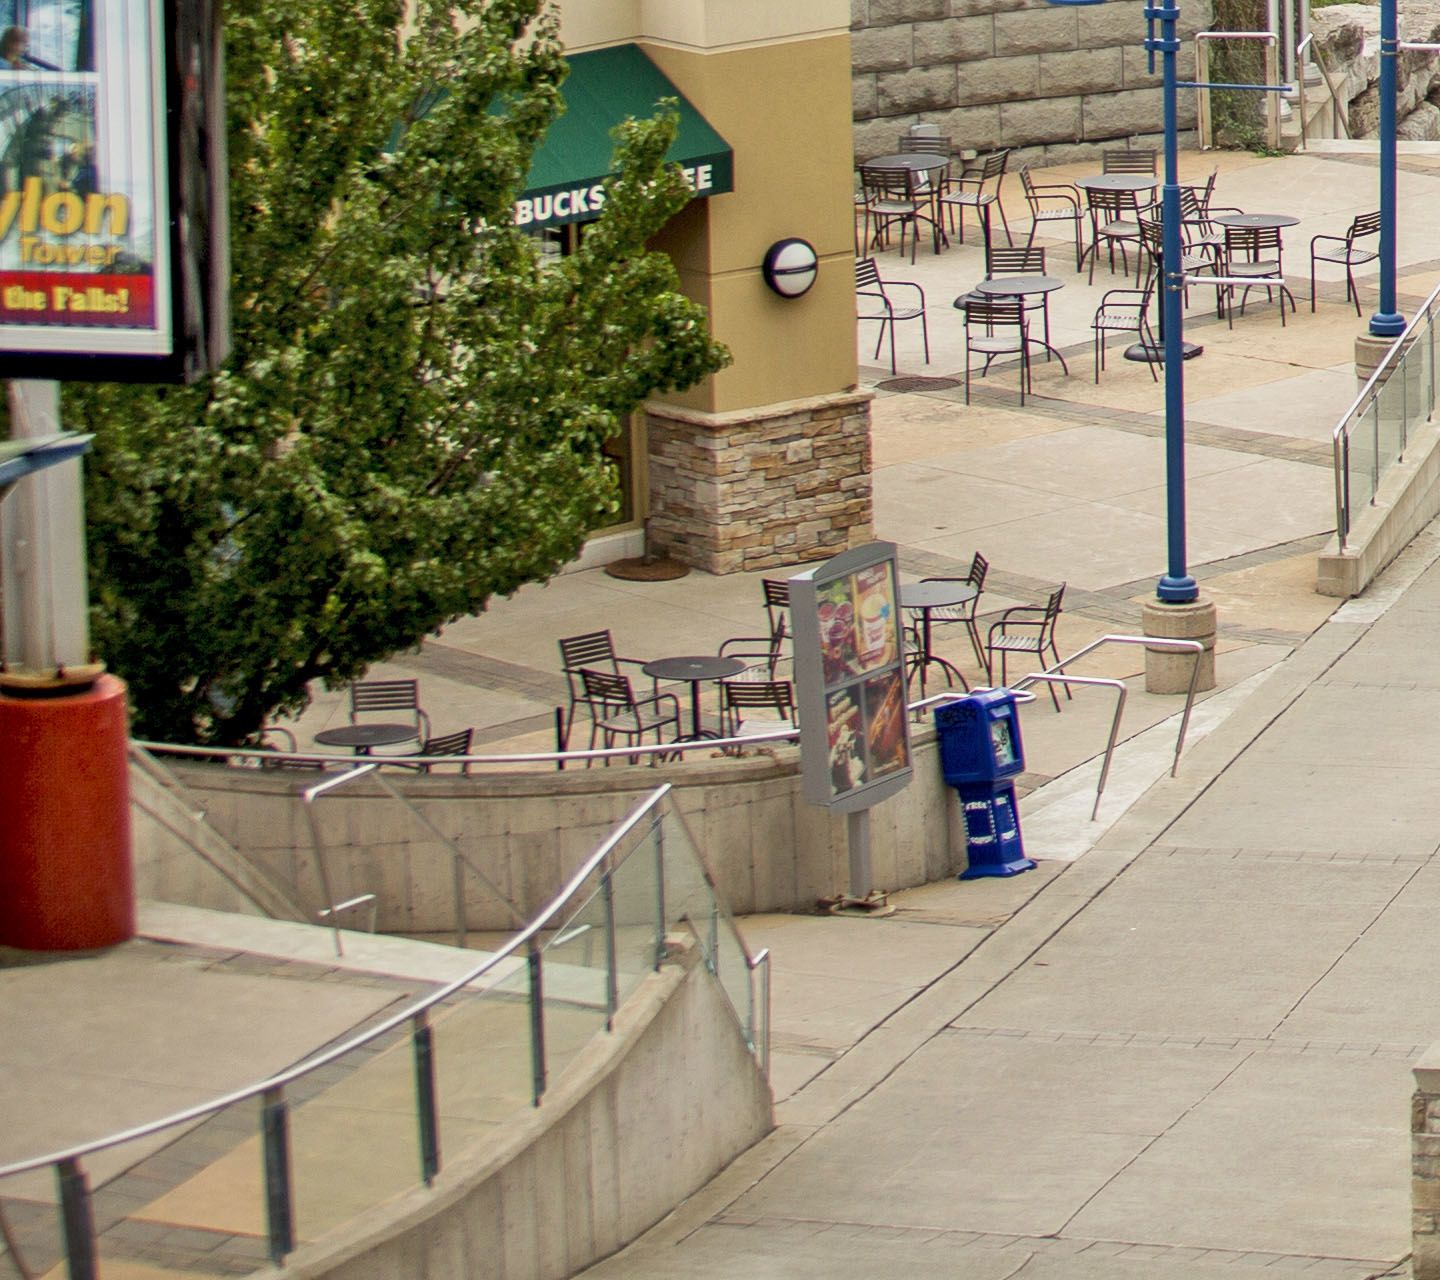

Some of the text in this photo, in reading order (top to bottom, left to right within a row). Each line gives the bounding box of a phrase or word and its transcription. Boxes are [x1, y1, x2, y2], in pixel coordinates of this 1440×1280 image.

[20, 236, 124, 265] Tower
[4, 285, 130, 313] the Falls!
